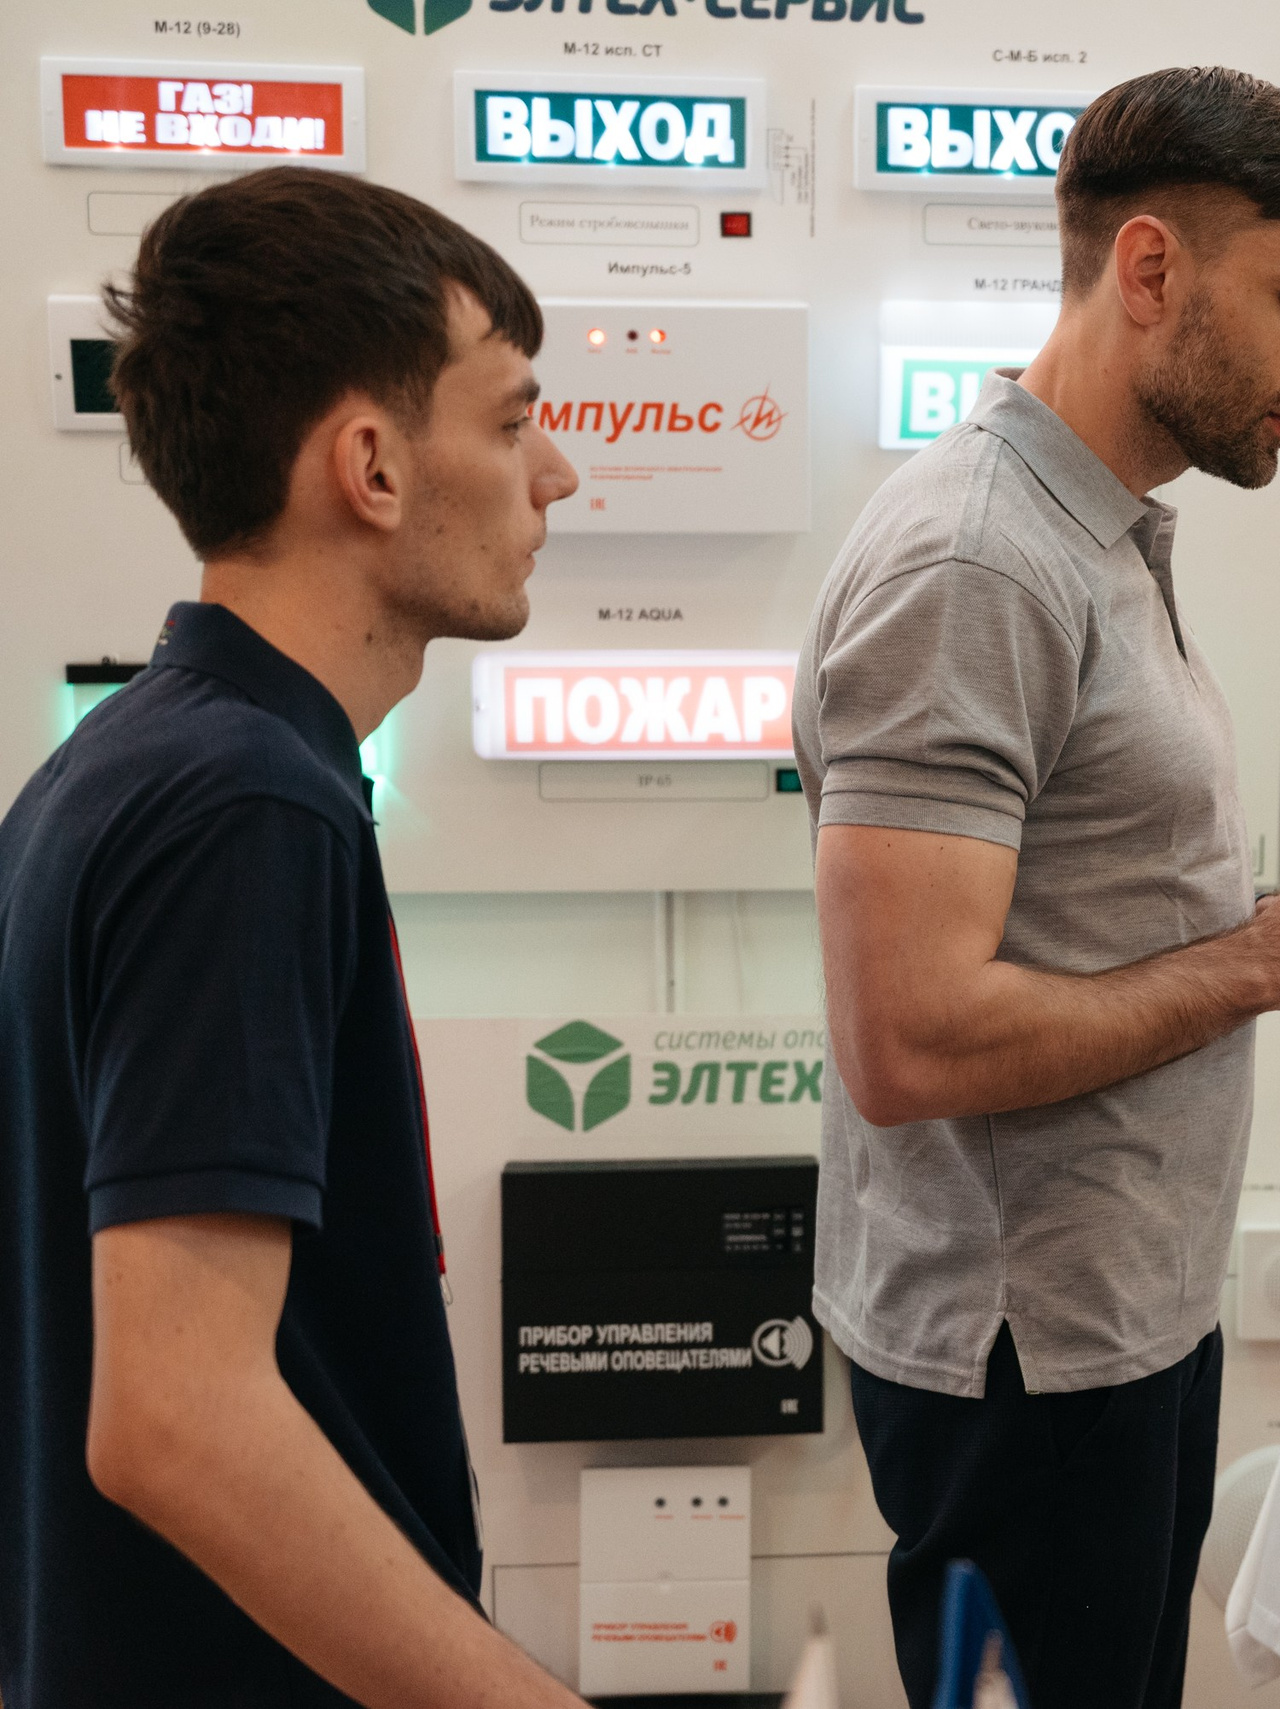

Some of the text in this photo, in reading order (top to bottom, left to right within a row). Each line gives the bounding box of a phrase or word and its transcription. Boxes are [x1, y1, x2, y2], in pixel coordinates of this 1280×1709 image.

[196, 21, 241, 37] (9-28)
[1079, 51, 1088, 64] 2
[158, 80, 254, 115] ГАЗ!
[84, 109, 325, 150] НЕ ВХОДИ!
[486, 96, 735, 164] ВЫХОД
[607, 261, 692, 277] Импульс-5
[638, 608, 684, 622] AQUA
[514, 675, 787, 745] ПОЖАР
[653, 1030, 776, 1051] системы
[648, 1060, 823, 1105] ЭЛТЕХ
[518, 1322, 714, 1348] ПРИБОР УПРАВЛЕНИЯ
[518, 1347, 753, 1374] РЕЧЕВЫМИ ОПОВЕЩАТЕЛЯМИ
